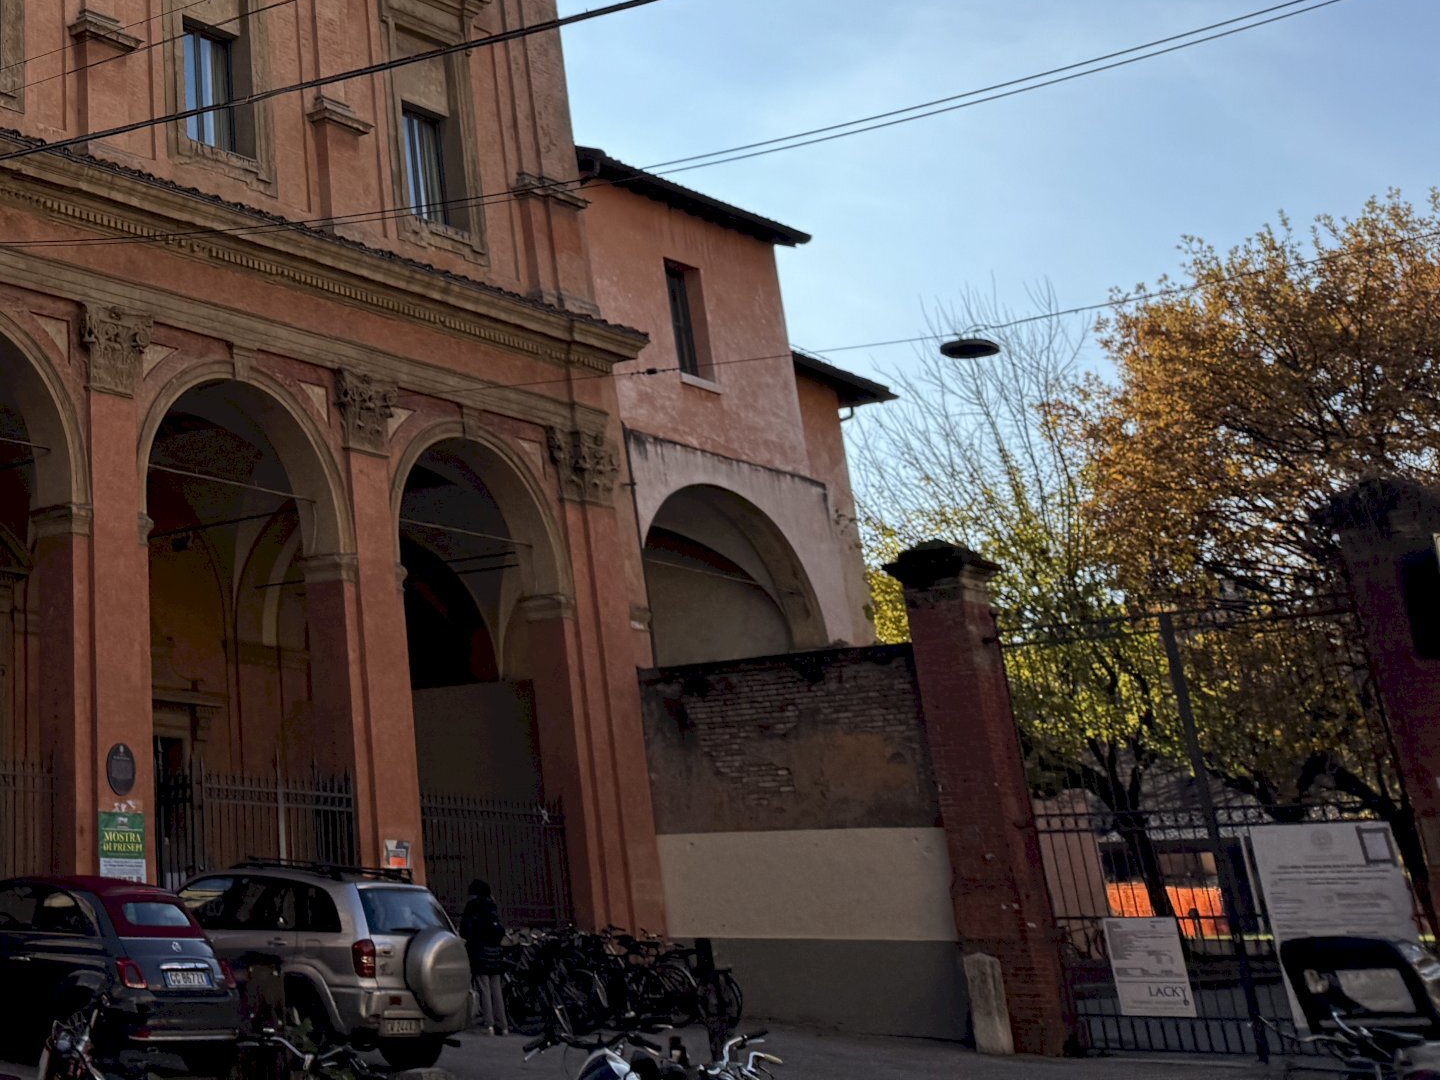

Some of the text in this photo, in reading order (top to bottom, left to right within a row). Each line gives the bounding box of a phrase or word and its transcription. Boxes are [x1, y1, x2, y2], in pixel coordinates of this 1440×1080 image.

[104, 831, 141, 842] MOSTRA
[103, 842, 142, 852] DI PRESEPI
[1148, 986, 1188, 1002] LACKY
